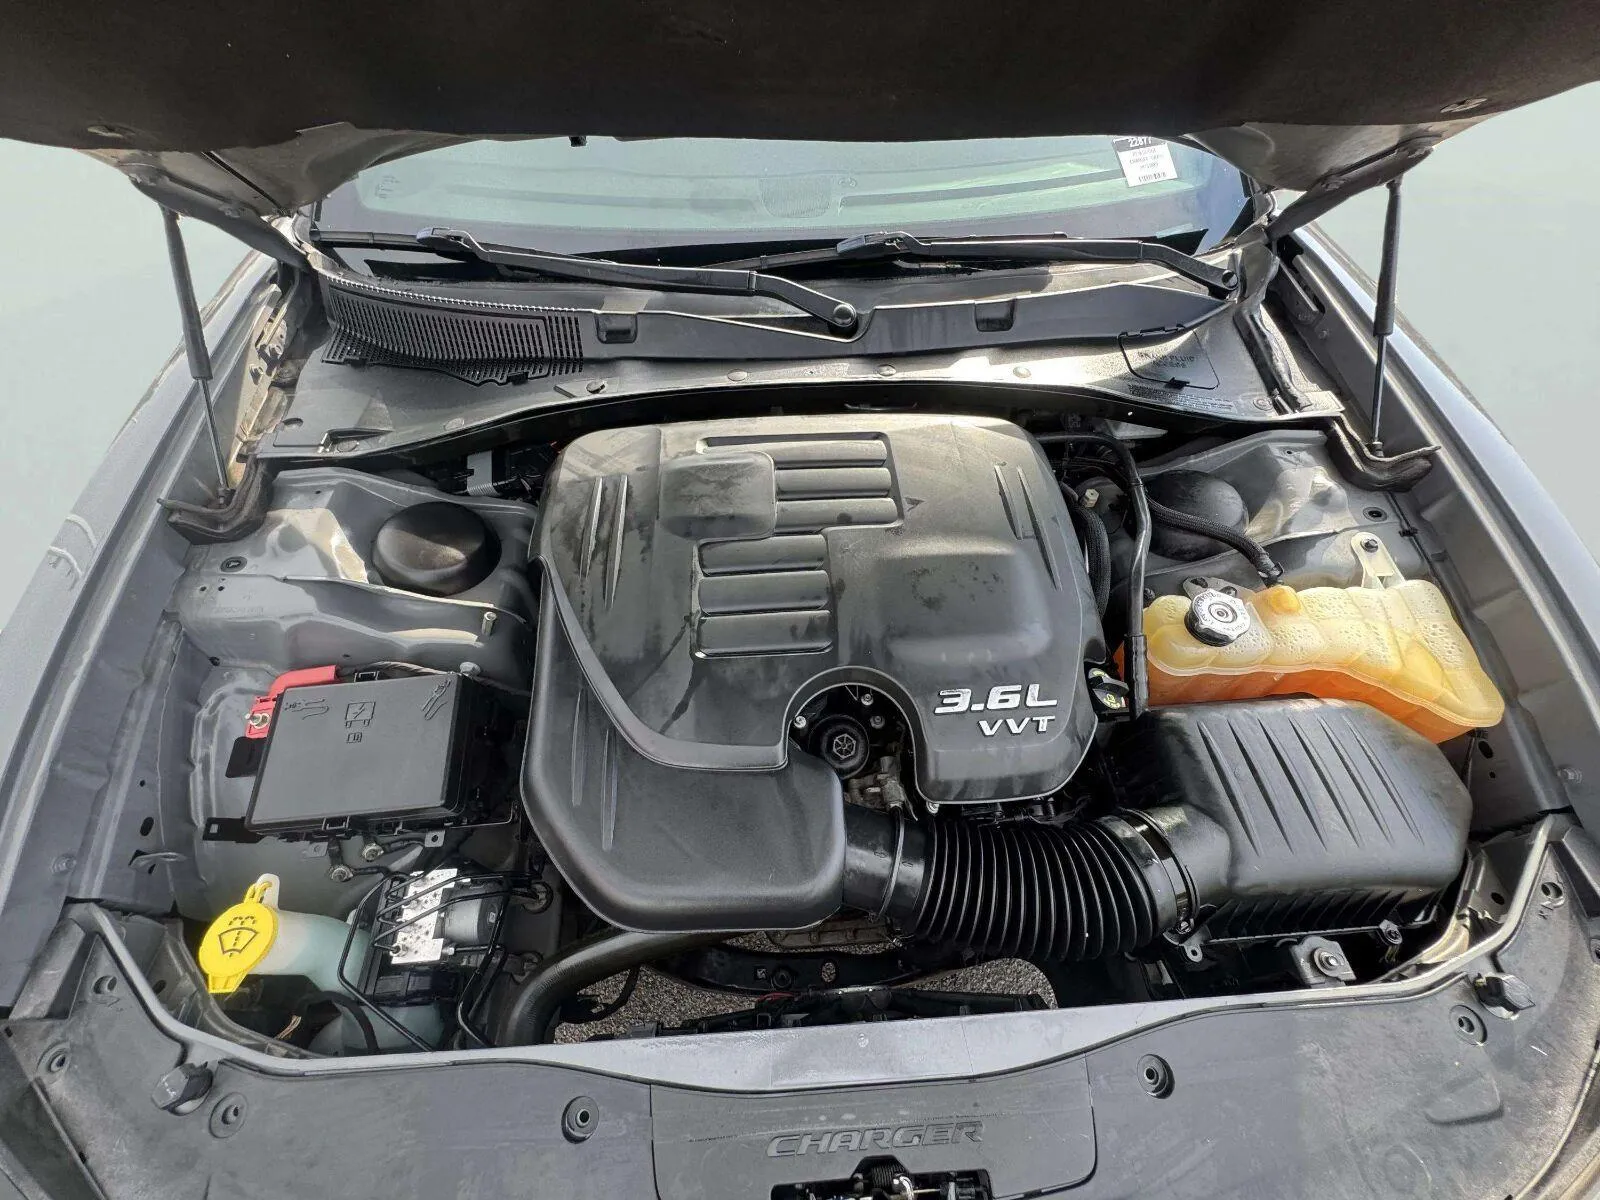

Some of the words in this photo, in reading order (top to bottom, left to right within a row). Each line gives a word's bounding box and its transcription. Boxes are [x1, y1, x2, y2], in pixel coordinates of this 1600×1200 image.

[935, 683, 1058, 713] 3.6L
[979, 715, 1056, 736] VVT
[766, 1120, 984, 1158] CHARGER
